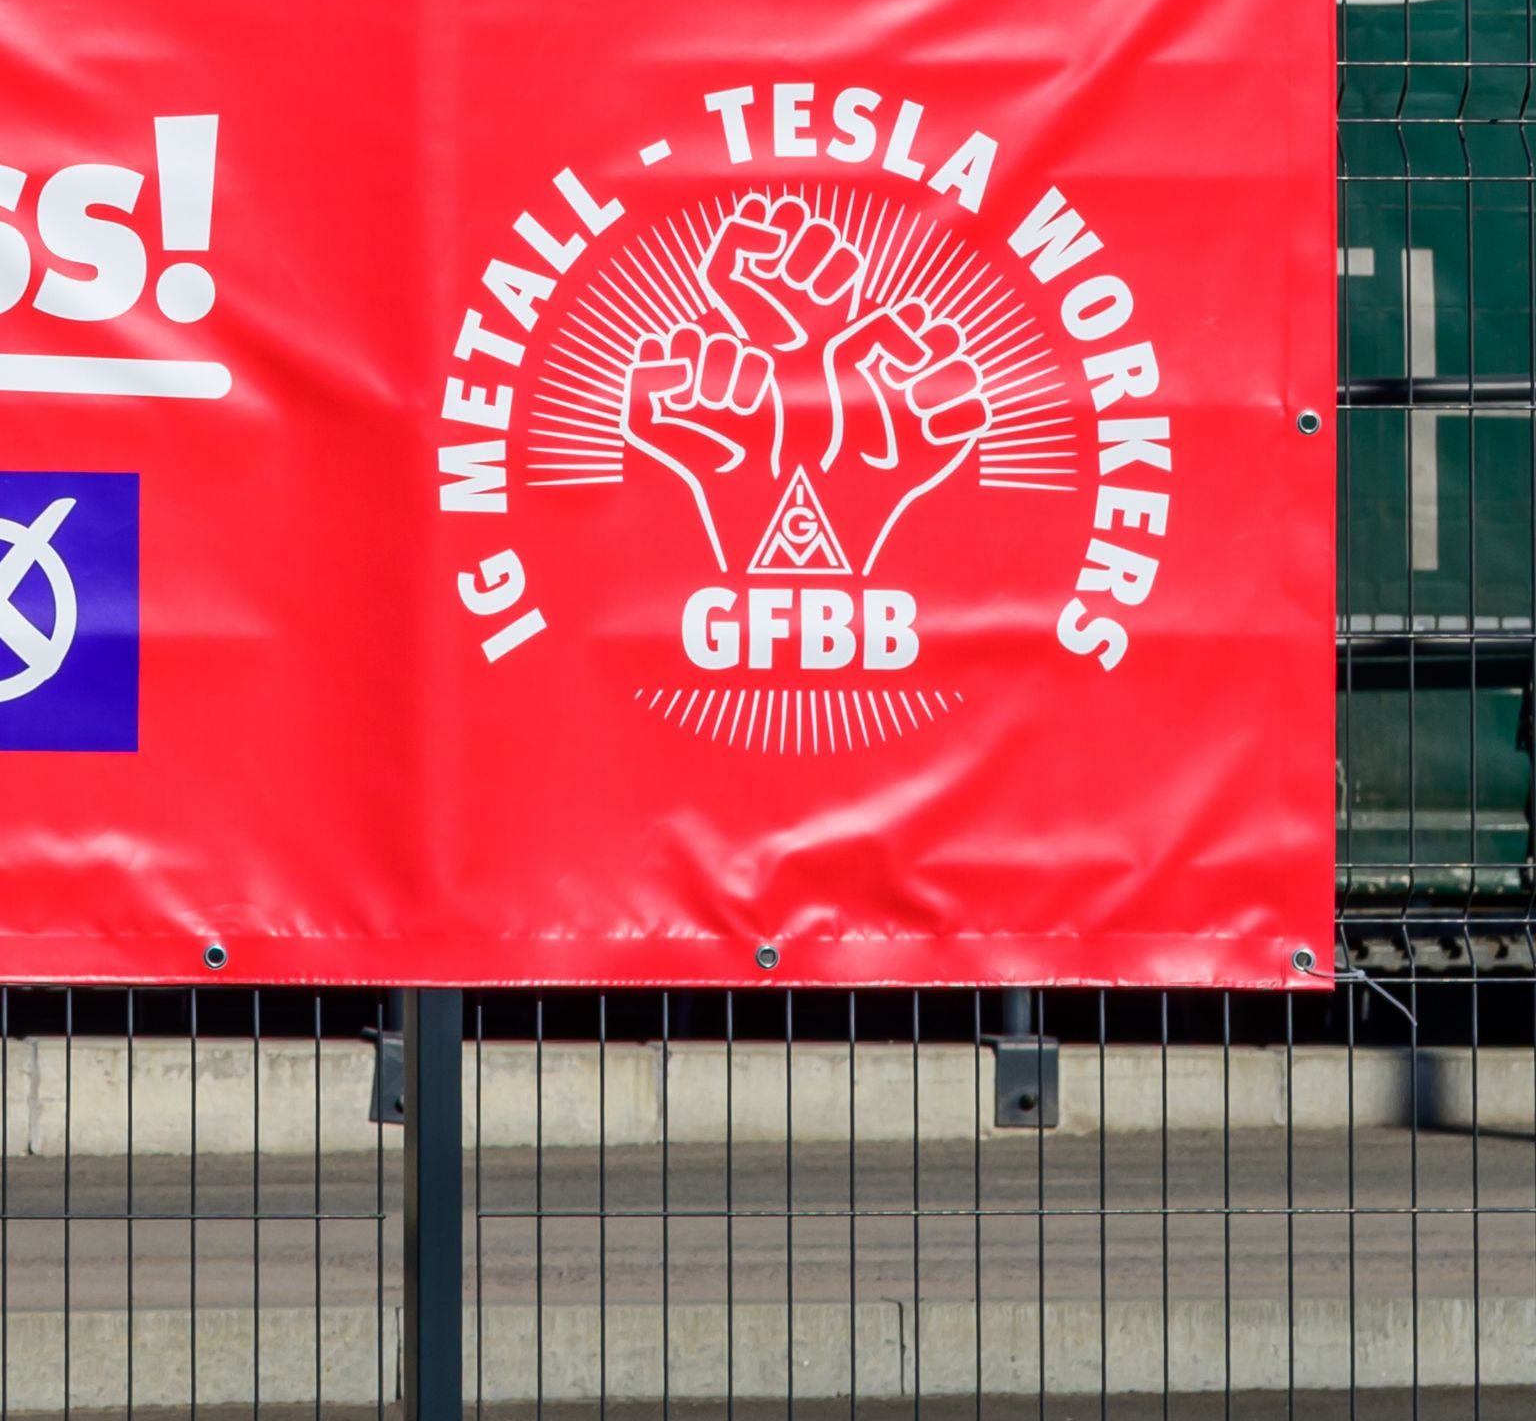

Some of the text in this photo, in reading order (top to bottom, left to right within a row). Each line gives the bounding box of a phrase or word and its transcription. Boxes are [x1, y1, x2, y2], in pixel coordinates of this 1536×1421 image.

[703, 82, 1000, 215] TESLA
[437, 166, 627, 514] METALL
[1006, 185, 1173, 673] WORKERS
[456, 547, 549, 664] IG
[680, 585, 921, 671] GFBB
